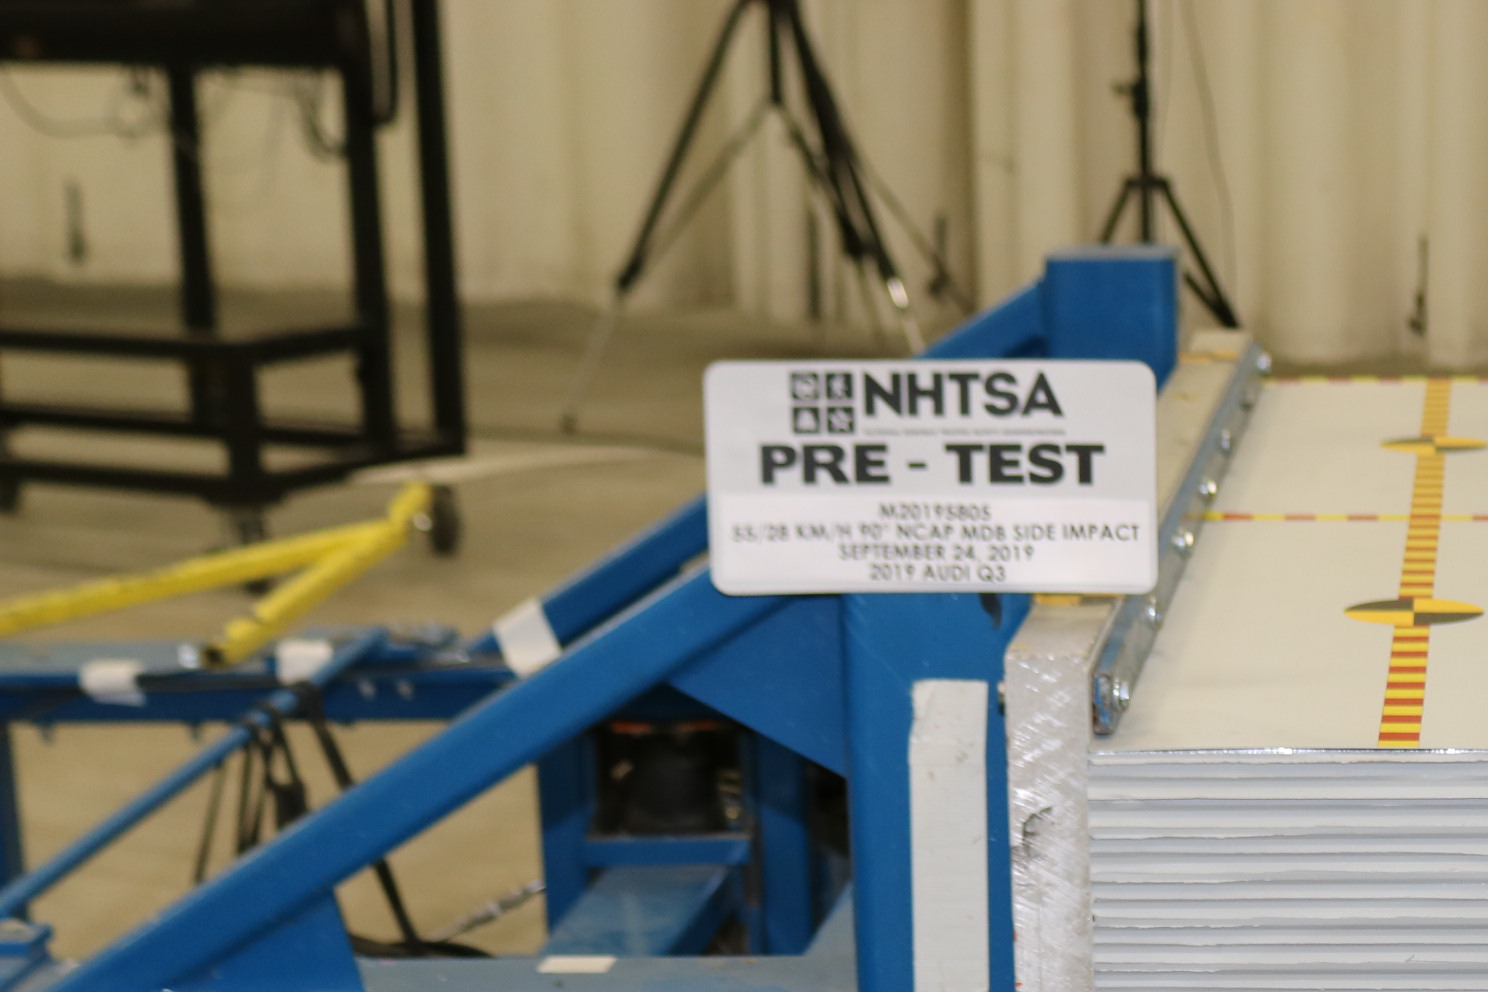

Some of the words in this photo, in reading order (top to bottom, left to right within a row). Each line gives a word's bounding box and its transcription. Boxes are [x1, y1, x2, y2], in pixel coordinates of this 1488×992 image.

[864, 371, 1063, 417] NHTSA
[760, 443, 891, 485] PRE
[944, 443, 1105, 485] TEST
[896, 523, 954, 541] NCAP
[962, 523, 1006, 541] MDB
[1013, 523, 1056, 541] SIDE
[1062, 523, 1140, 541] IMPACT
[839, 543, 946, 561] SEPTEMBER
[988, 543, 1035, 561] 2019
[870, 562, 915, 581] 2019
[923, 563, 971, 582] AUDI
[977, 564, 1006, 583] Q3
